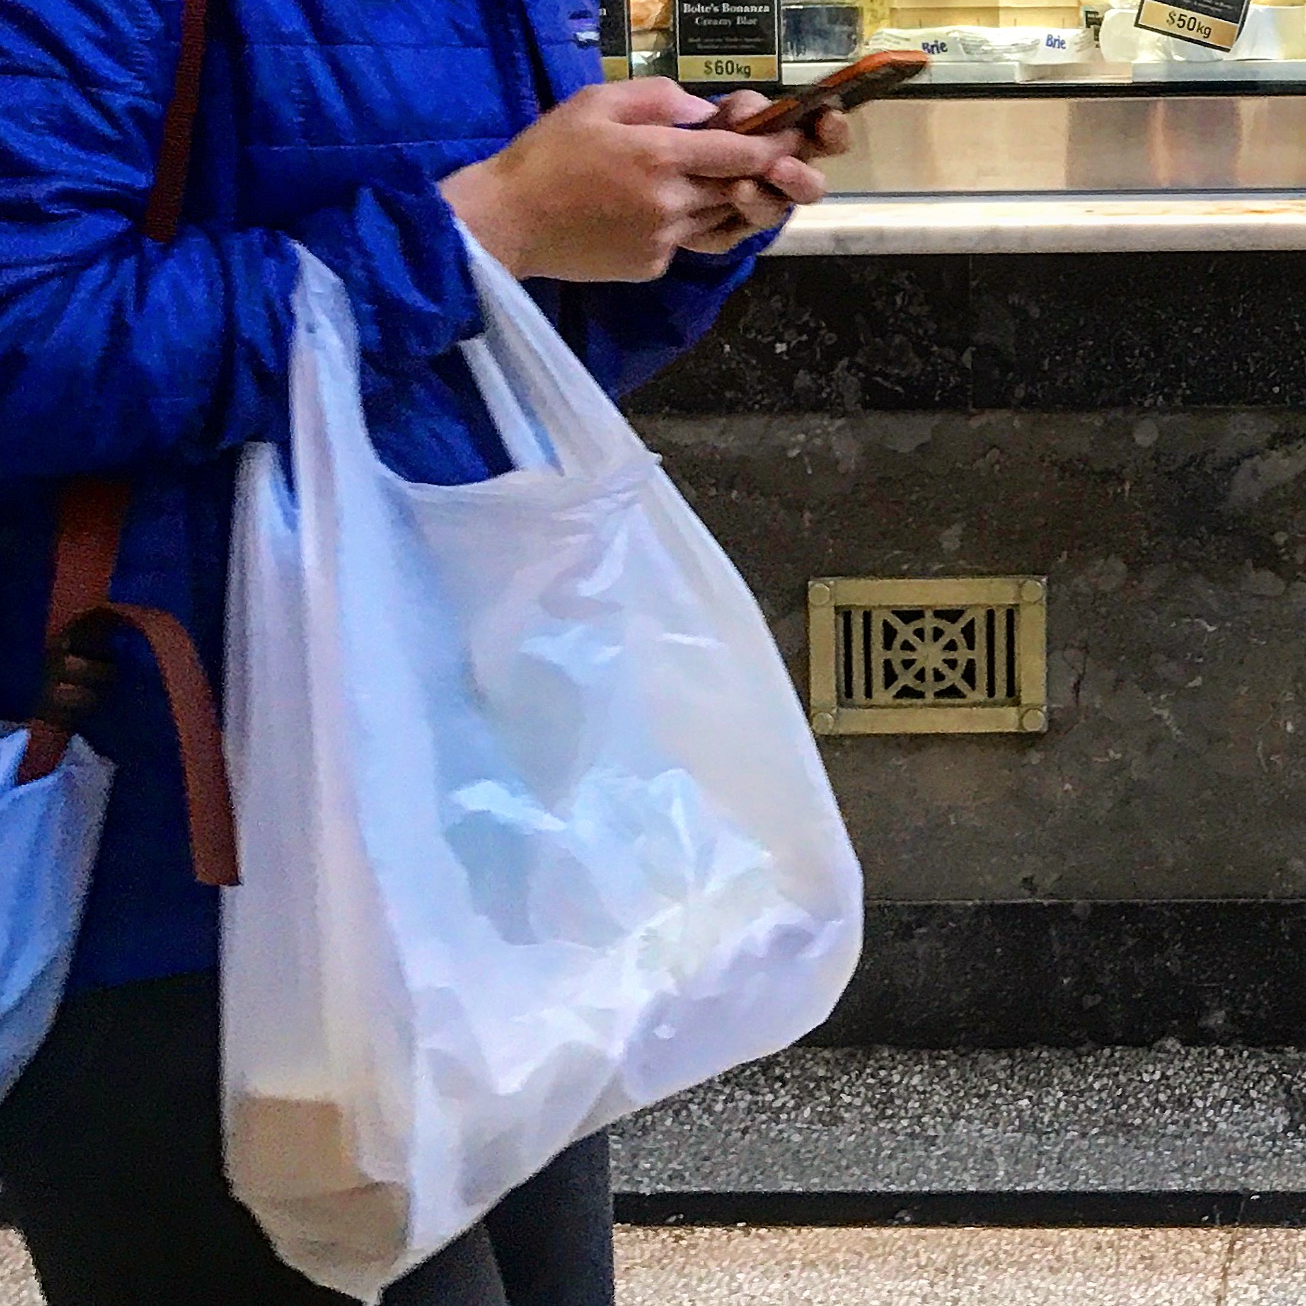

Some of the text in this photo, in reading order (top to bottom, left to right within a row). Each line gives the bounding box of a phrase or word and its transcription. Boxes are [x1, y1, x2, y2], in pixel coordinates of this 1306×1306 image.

[722, 2, 770, 13] Bonanza
[921, 39, 949, 55] Brie
[1045, 34, 1066, 50] Brie
